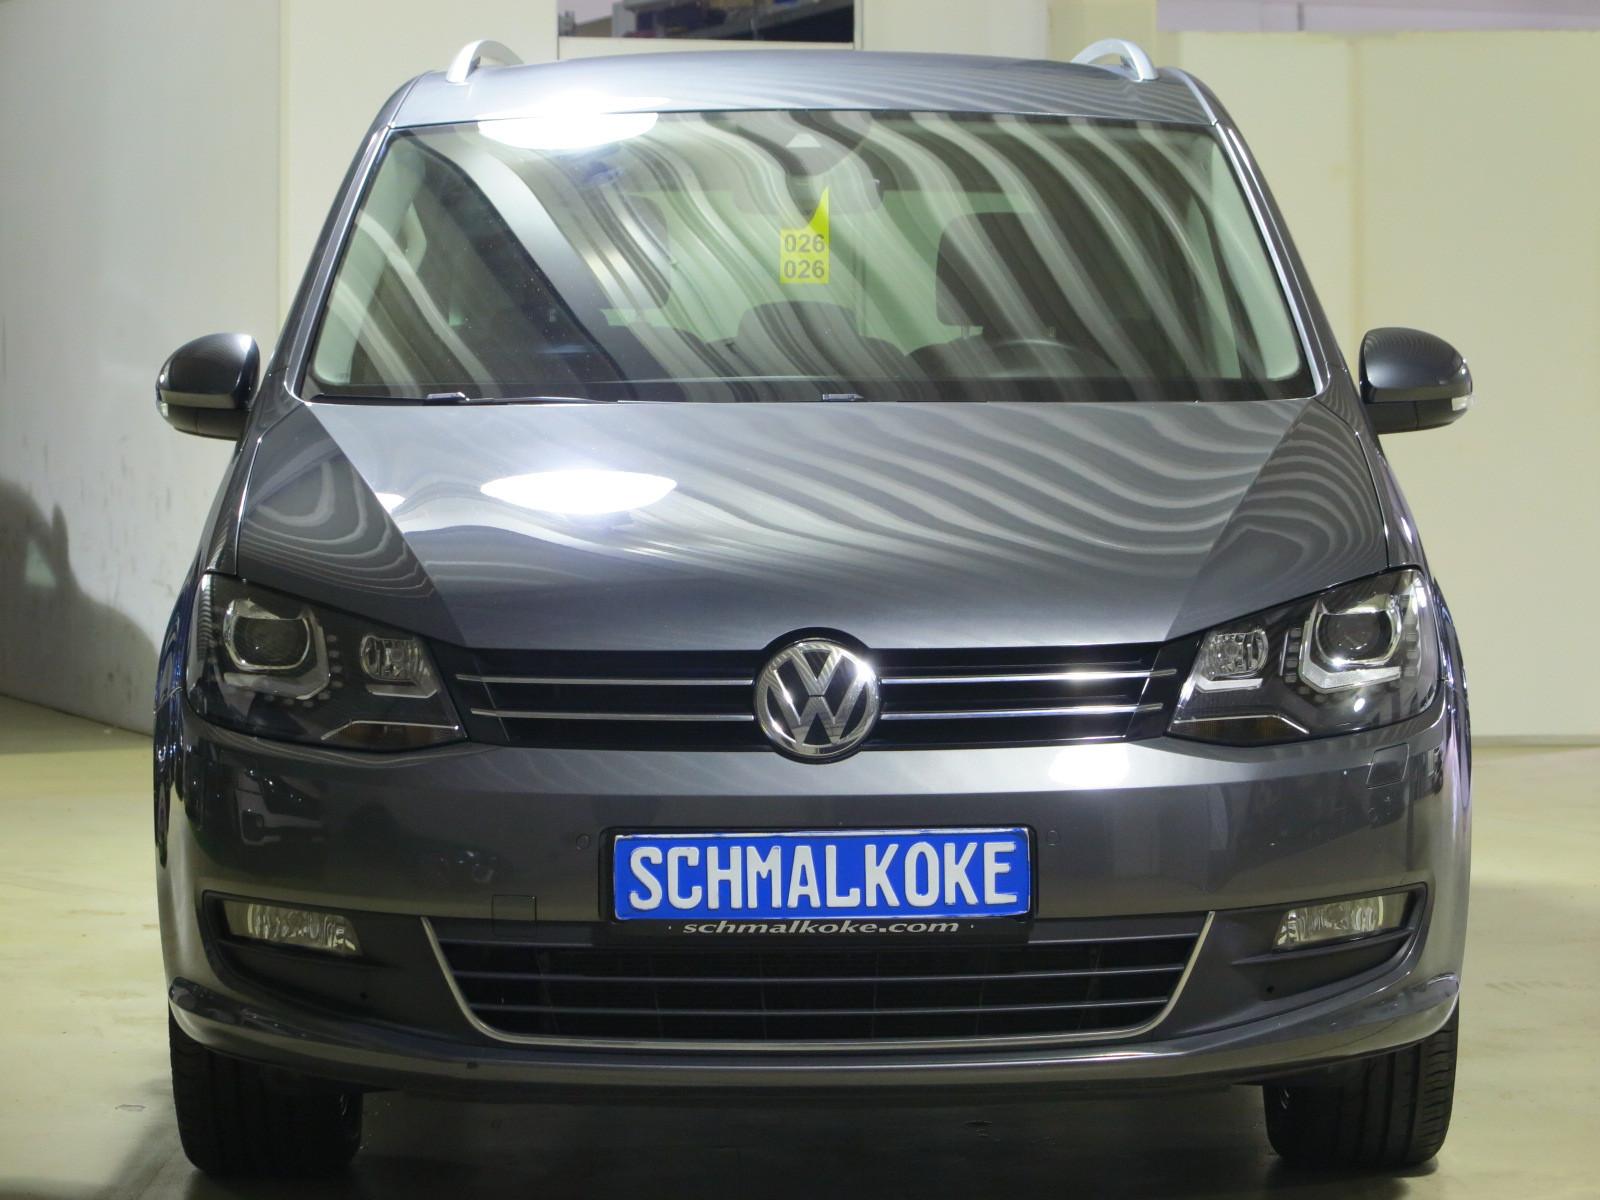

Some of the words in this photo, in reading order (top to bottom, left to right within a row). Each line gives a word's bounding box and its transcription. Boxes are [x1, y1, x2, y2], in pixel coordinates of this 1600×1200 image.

[784, 234, 825, 253] 026
[784, 260, 825, 279] 026
[629, 841, 1017, 910] SCHMALKOKE
[682, 919, 960, 934] schmalkoke.com
